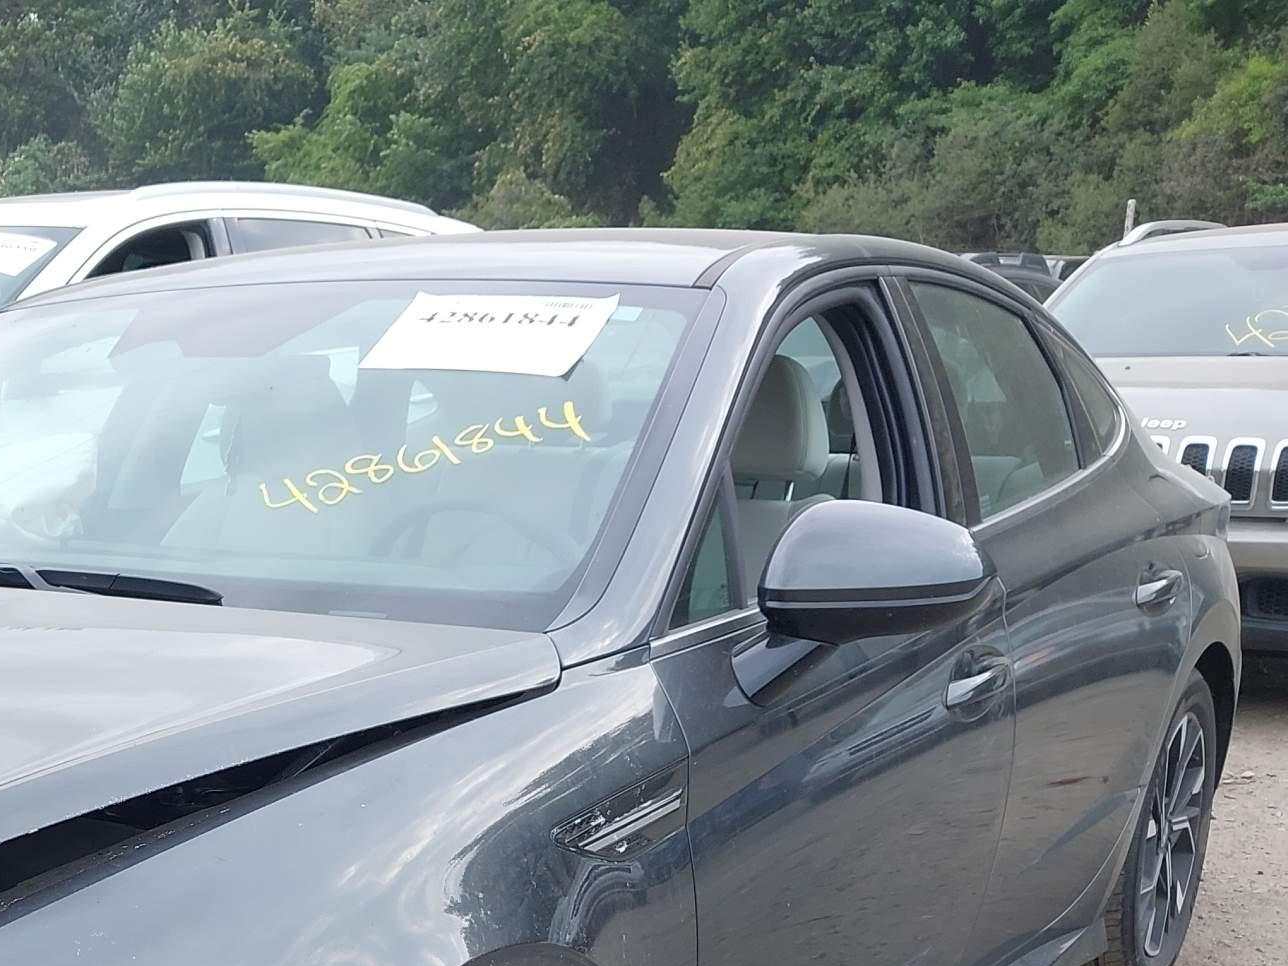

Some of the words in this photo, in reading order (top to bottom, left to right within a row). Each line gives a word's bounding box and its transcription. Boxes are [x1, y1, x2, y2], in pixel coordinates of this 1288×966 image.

[418, 310, 581, 328] 42861844
[1224, 304, 1288, 349] 42
[259, 400, 593, 514] 42861844
